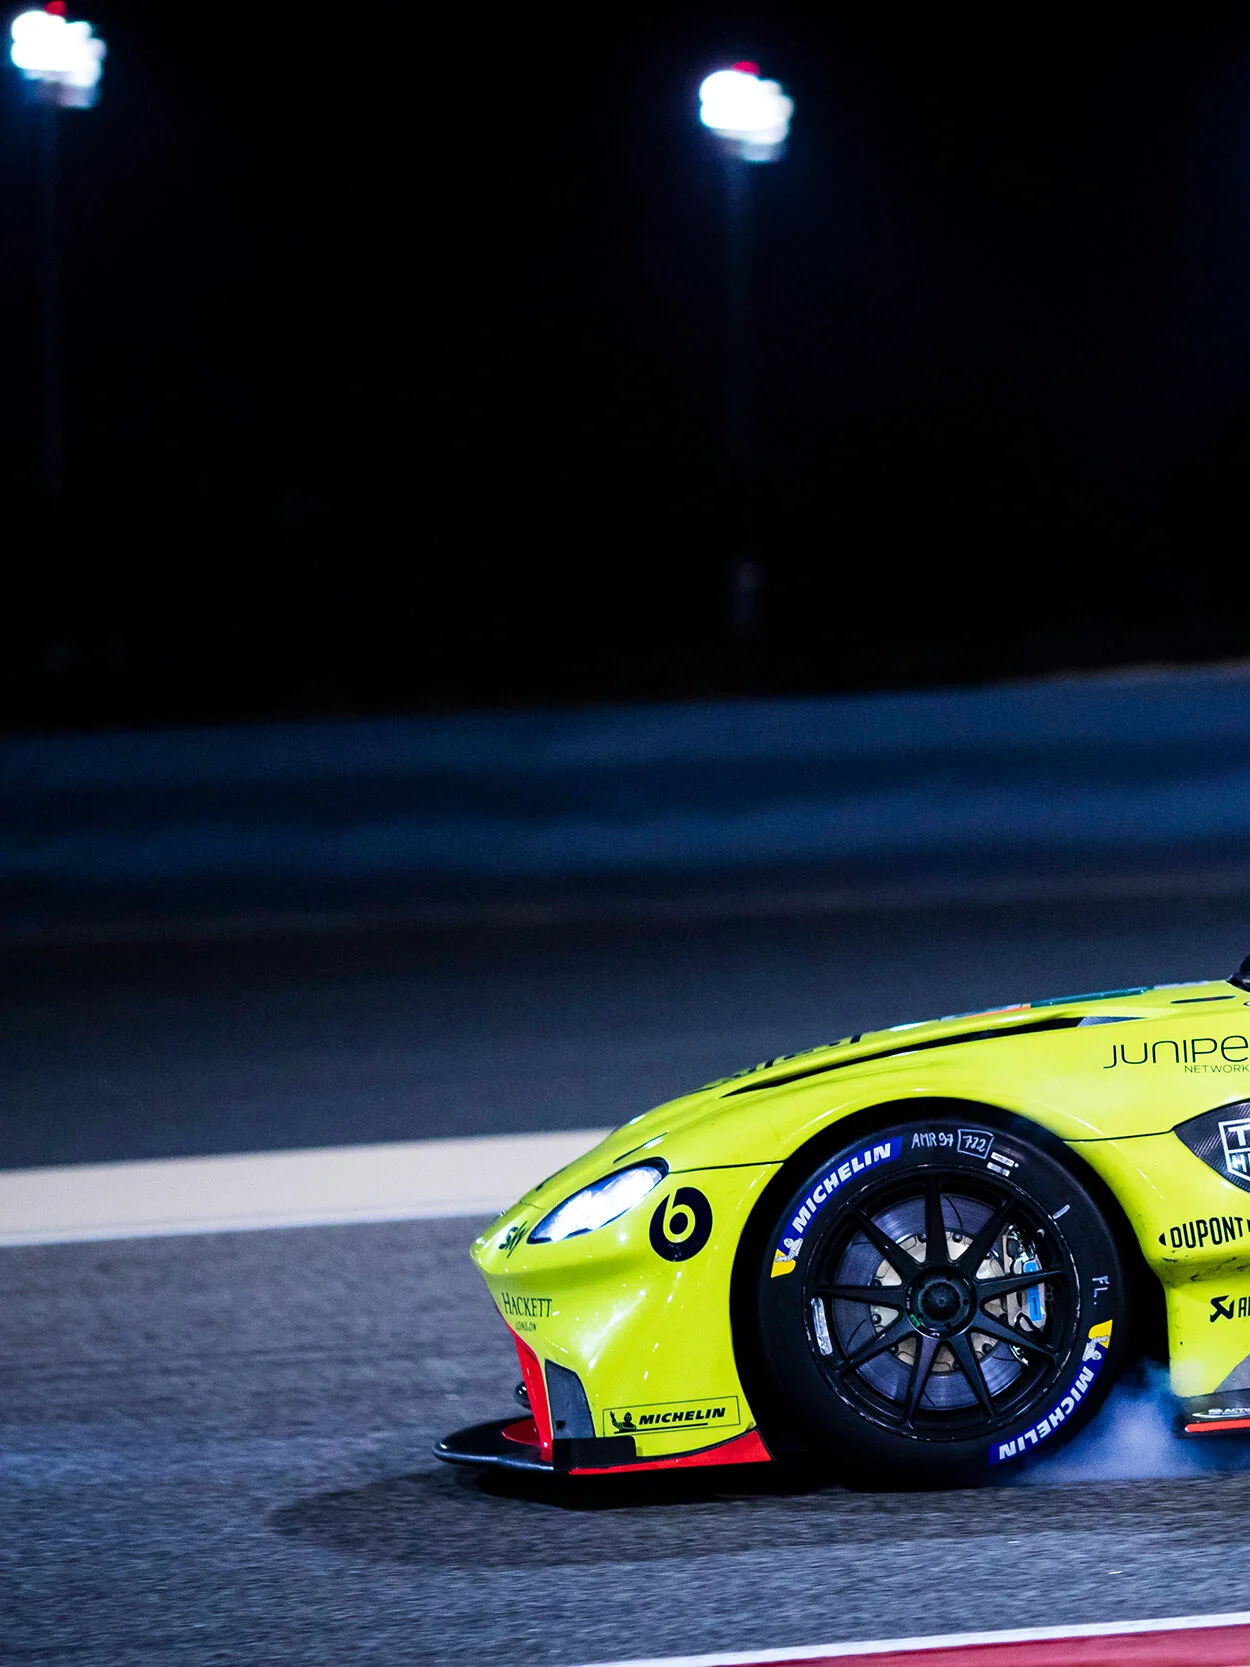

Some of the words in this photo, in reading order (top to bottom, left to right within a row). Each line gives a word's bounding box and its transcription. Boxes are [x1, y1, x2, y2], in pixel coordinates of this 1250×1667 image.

[792, 1143, 892, 1233] MICHELIN
[1170, 1216, 1244, 1249] DUPONT
[501, 1292, 553, 1317] HACKETT
[639, 1407, 726, 1425] MICHELIN
[999, 1366, 1095, 1459] MICHELIN
